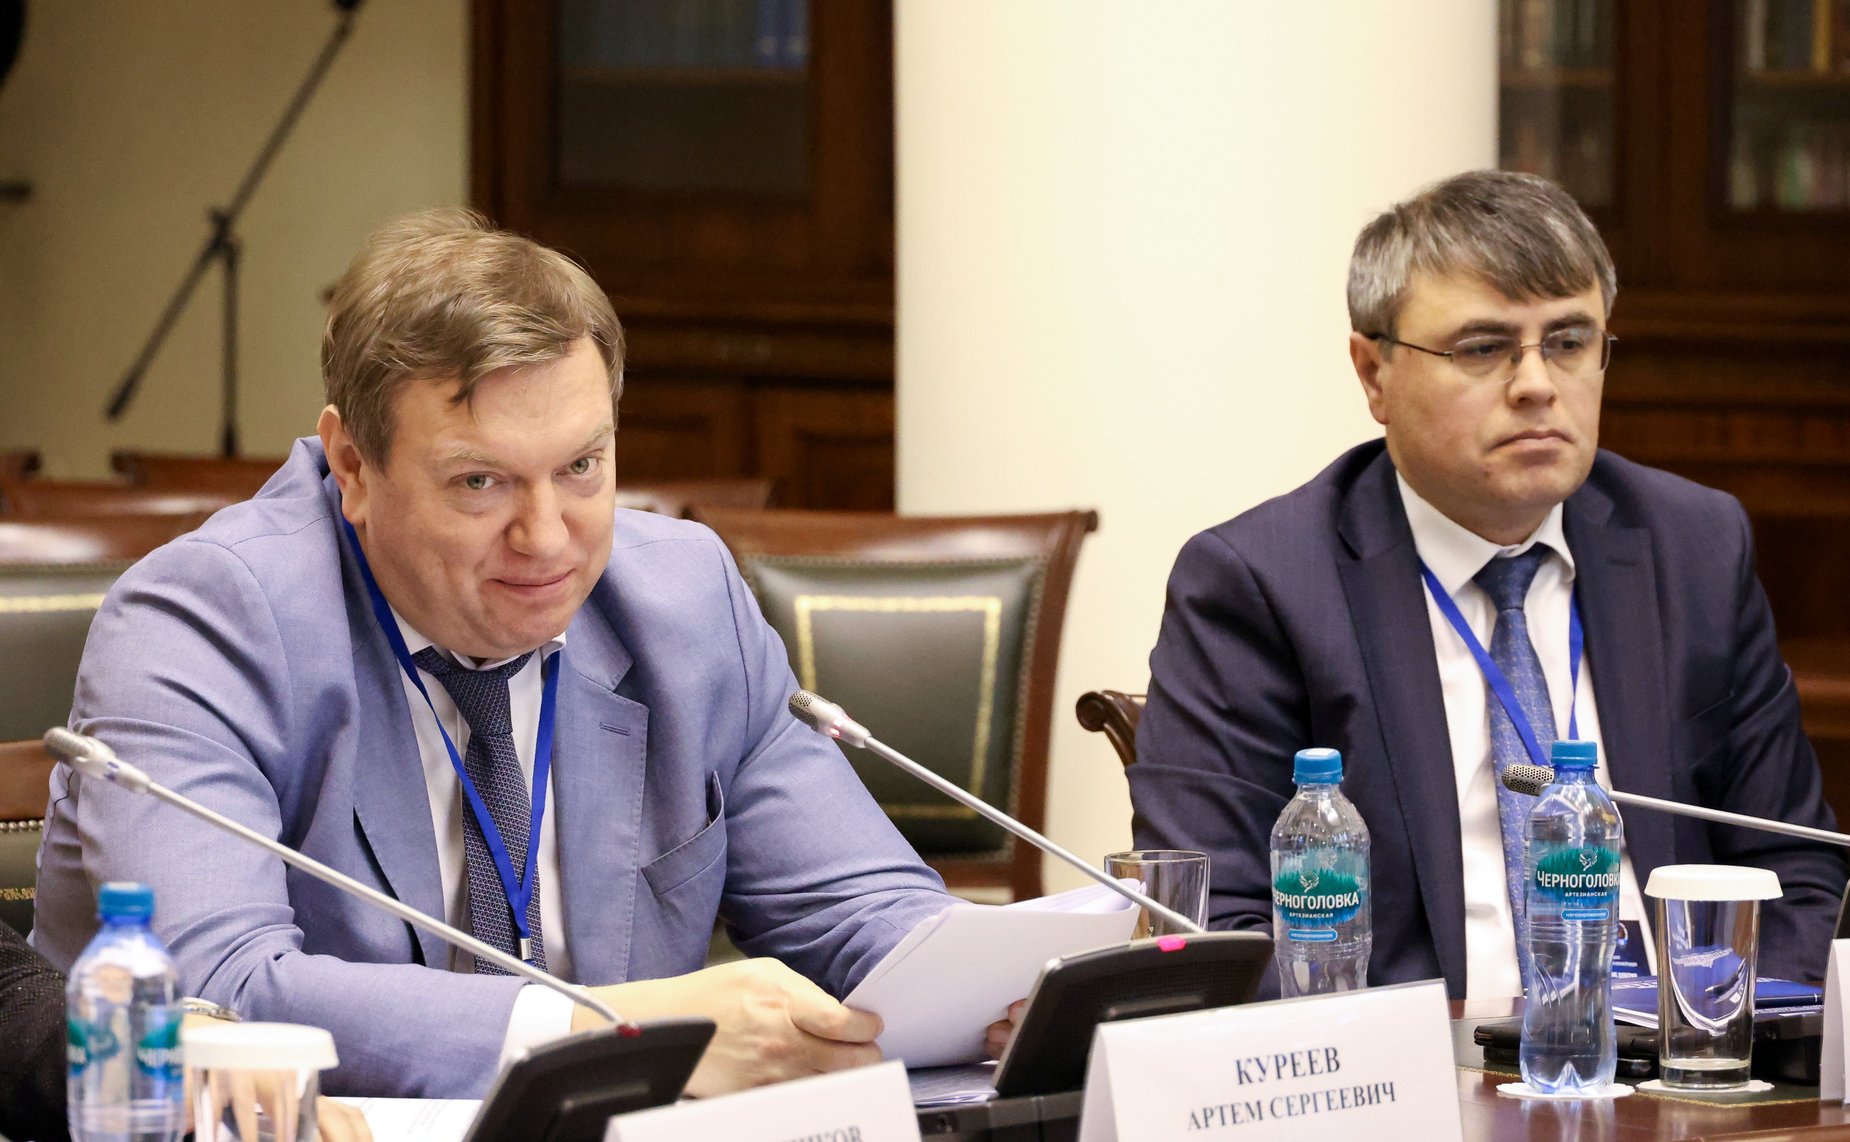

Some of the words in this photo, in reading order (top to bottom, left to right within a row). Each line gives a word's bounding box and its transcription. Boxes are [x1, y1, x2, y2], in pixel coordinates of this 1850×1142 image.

[1537, 870, 1620, 888] ЧЕРНОГОЛОВК
[1273, 891, 1359, 909] ЕРНОГОЛОВКА
[1235, 1046, 1341, 1085] КУРЕЕВ
[1187, 1100, 1264, 1131] АРТЕМ
[1269, 1081, 1396, 1119] СЕРГЕЕВИЧ
